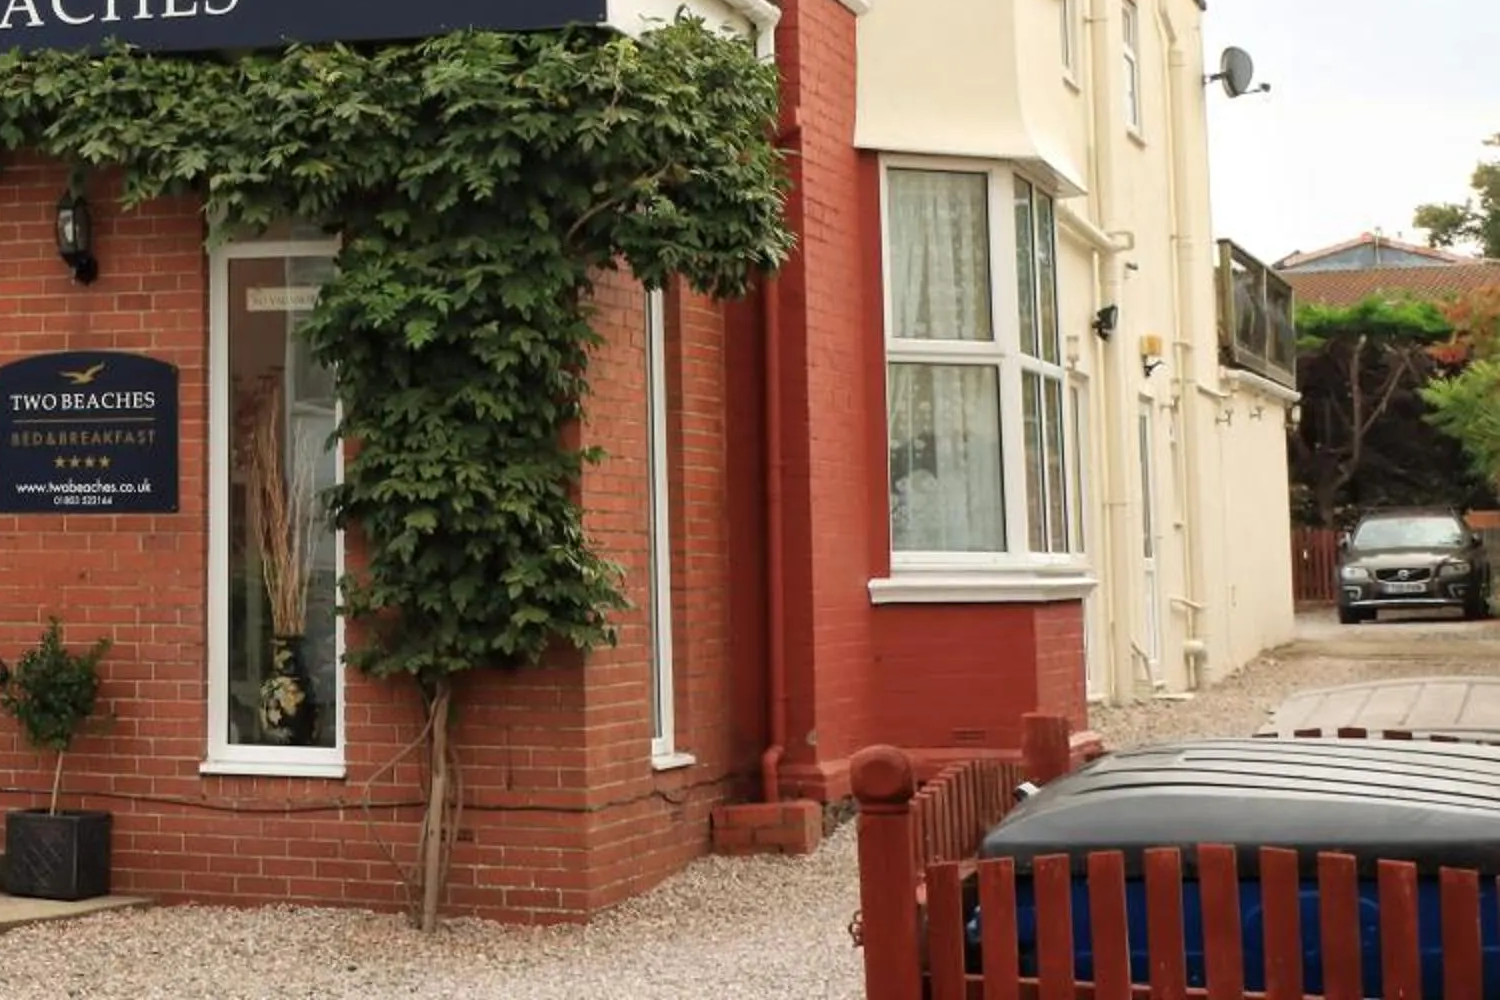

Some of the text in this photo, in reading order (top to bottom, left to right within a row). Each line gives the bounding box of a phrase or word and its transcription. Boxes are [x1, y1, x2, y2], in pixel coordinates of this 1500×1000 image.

[10, 391, 155, 411] TWO BEACHES
[15, 478, 152, 493] www.twobeaches.co.uk
